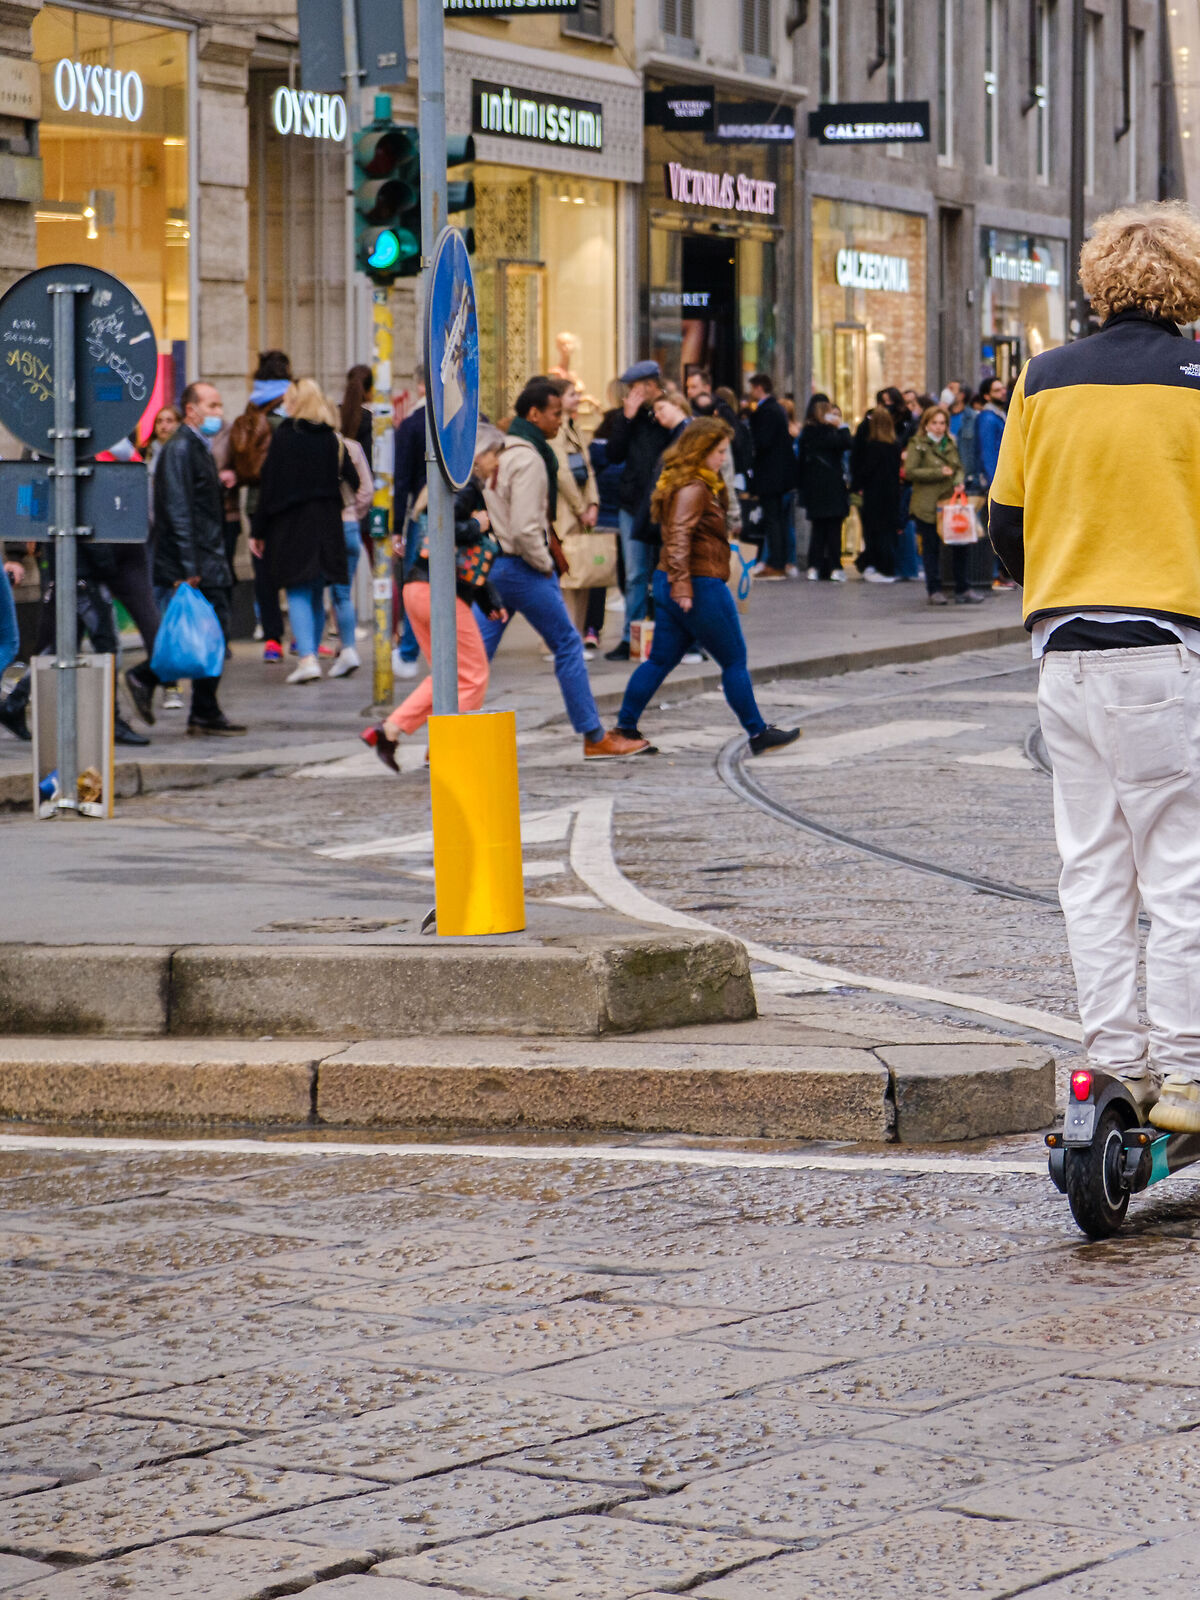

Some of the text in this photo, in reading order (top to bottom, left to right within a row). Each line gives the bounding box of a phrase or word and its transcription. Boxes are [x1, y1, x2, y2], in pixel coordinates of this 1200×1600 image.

[54, 58, 144, 122] OYSHO
[272, 86, 347, 142] OYSHO
[481, 87, 602, 148] intimissimi
[824, 122, 924, 140] CALZEDONIA
[668, 162, 776, 215] VICTORIA'S SECRET
[836, 248, 909, 293] CALZEDONIA
[659, 292, 711, 307] SECRET
[1180, 365, 1200, 373] NORTH
[1184, 369, 1200, 377] FACE
